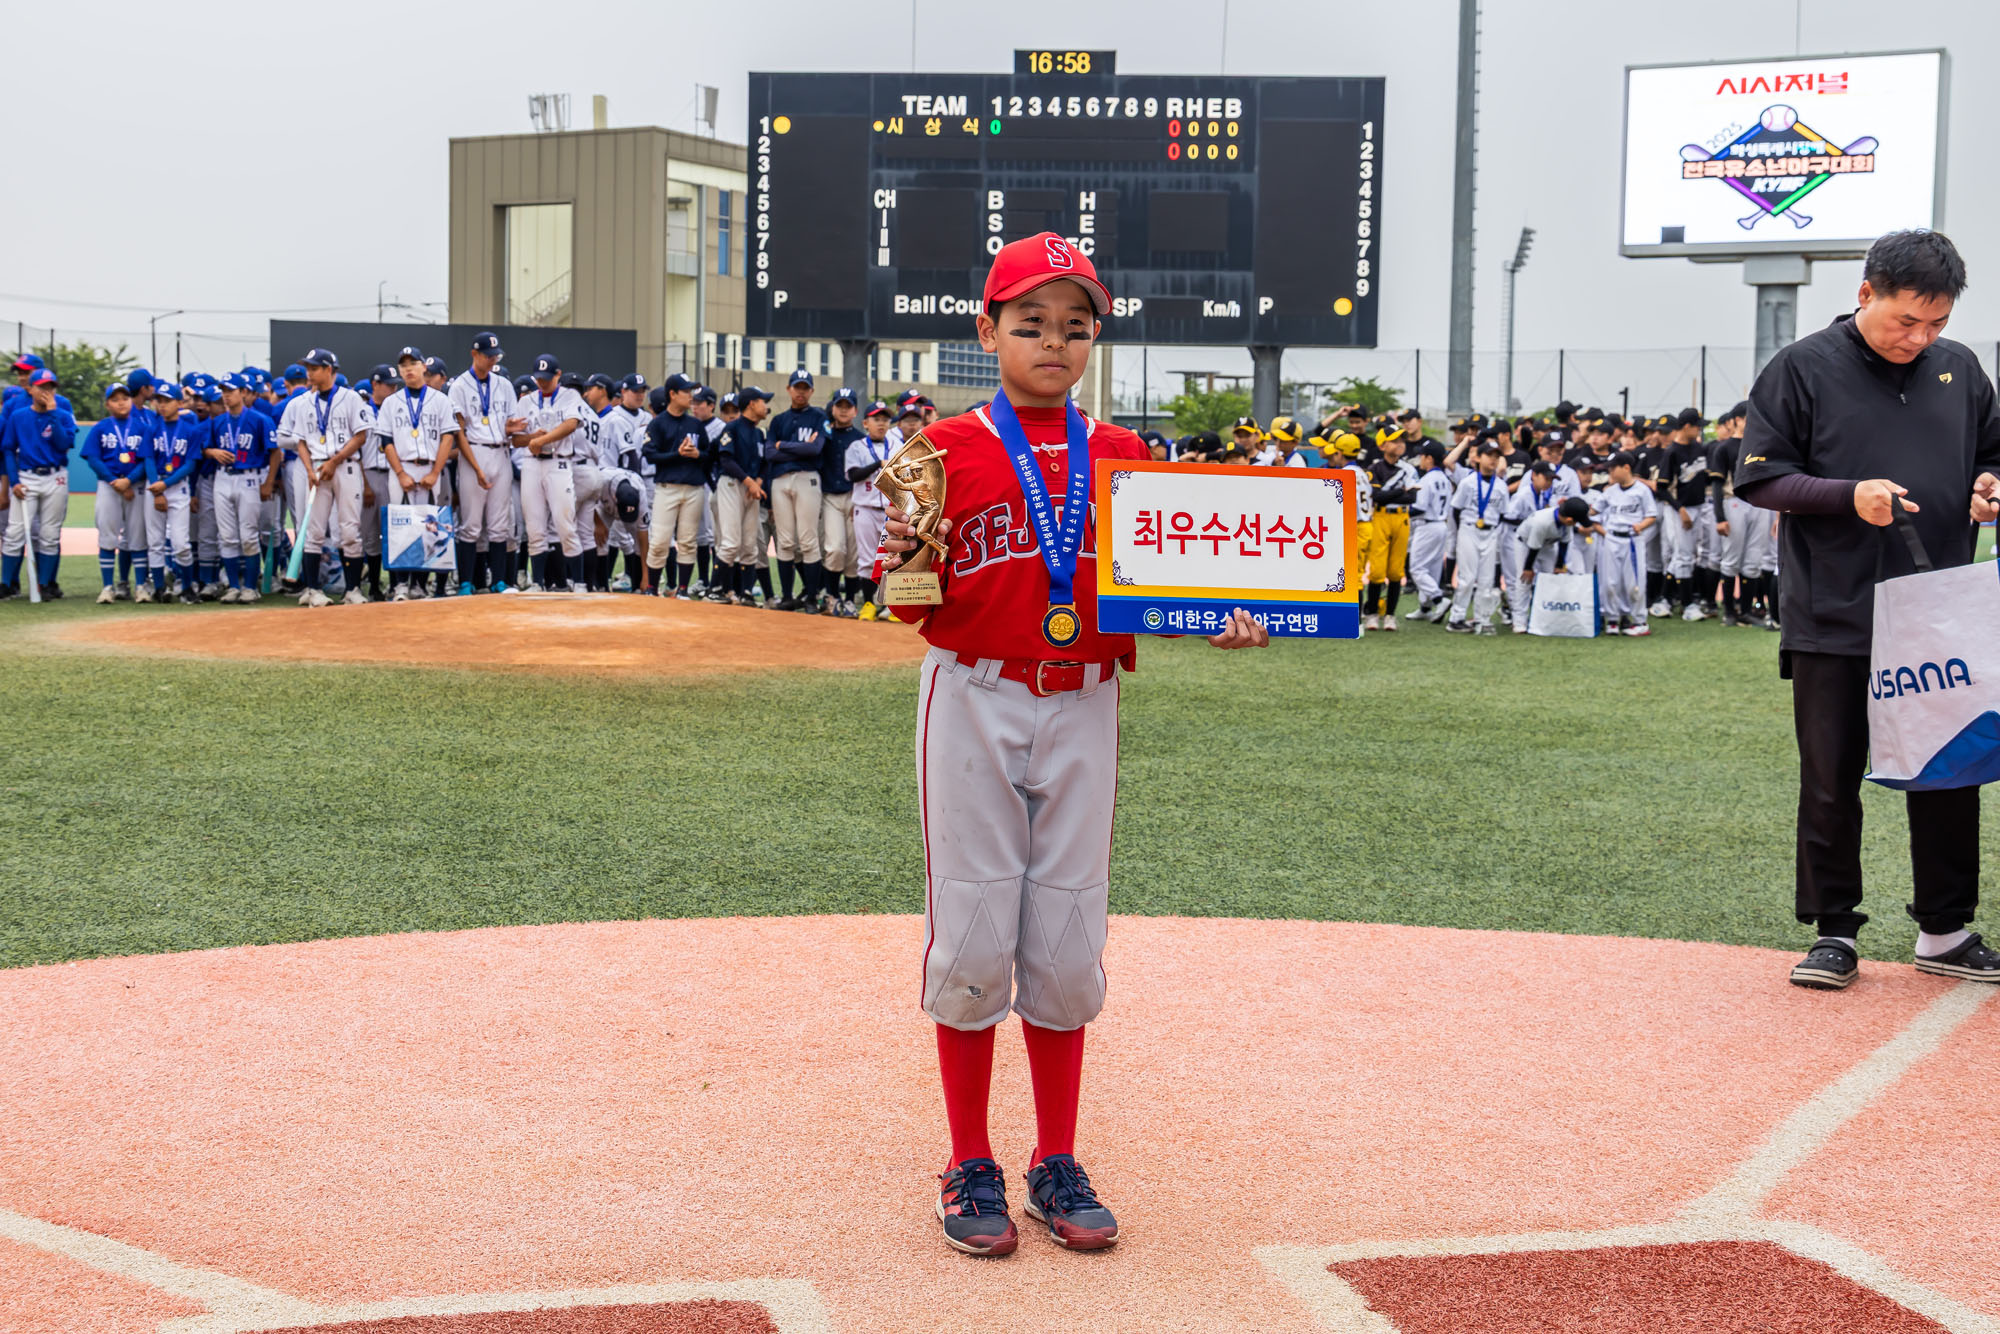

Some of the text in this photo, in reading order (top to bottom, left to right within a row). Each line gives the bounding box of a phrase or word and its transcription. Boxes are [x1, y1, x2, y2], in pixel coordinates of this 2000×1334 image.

[1029, 52, 1091, 74] 16:58
[1716, 72, 1848, 95] 시사저널
[902, 95, 967, 116] TEAM
[990, 119, 1001, 135] 0
[1683, 155, 1875, 178] 전국유소년야구대회
[757, 116, 770, 288] 1 2 3 4 5 6 7 8 9
[874, 189, 896, 208] CH
[988, 190, 1004, 210] B
[1080, 191, 1096, 211] H
[1356, 122, 1373, 296] 1 2 3 4 5 6 7 8 9
[988, 213, 1003, 232] S
[1080, 214, 1094, 234] E
[1045, 237, 1073, 269] S
[774, 291, 788, 308] P
[895, 295, 984, 315] Ball Cou
[1203, 300, 1240, 318] Km/h
[1259, 297, 1273, 315] P
[539, 360, 548, 370] D
[797, 369, 808, 379] W
[724, 393, 735, 402] W
[840, 388, 851, 397] W
[338, 432, 346, 444] 6
[798, 427, 813, 442] W
[866, 481, 872, 492] 5
[1017, 453, 1061, 567] 2025 화성시장배 전국유소년야구대회
[1439, 496, 1447, 516] 7
[1133, 509, 1329, 560] 최우수선수상
[1869, 658, 1972, 700] USANA
